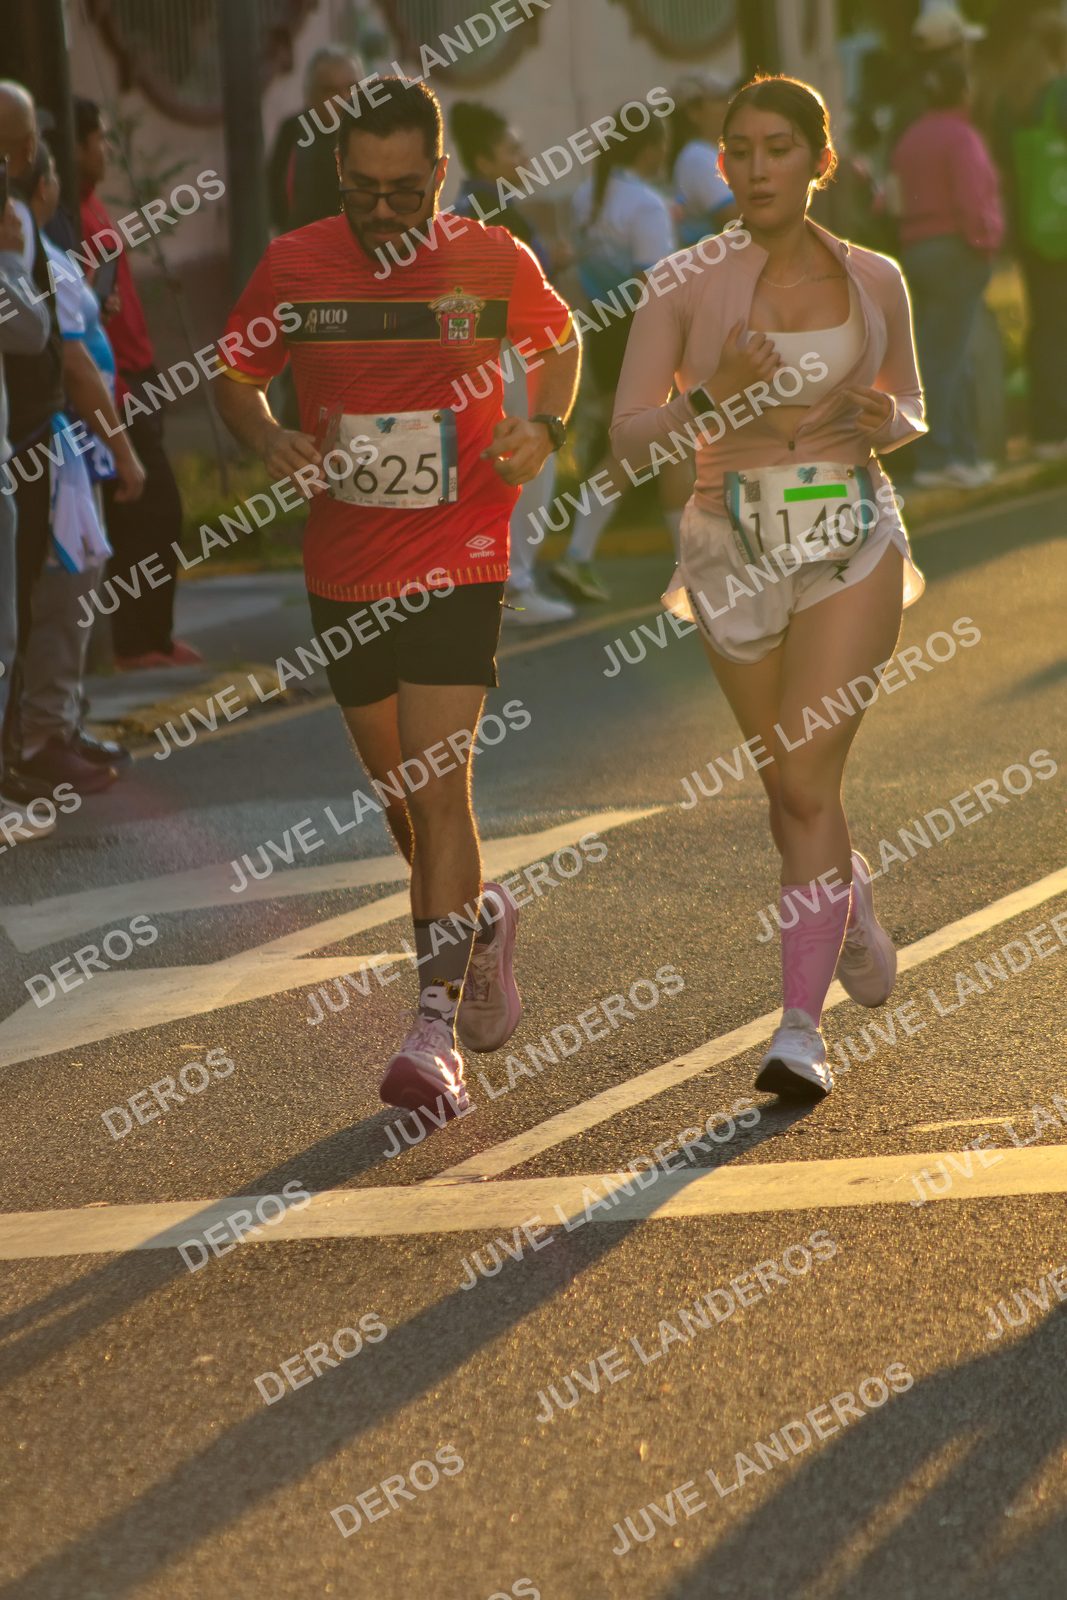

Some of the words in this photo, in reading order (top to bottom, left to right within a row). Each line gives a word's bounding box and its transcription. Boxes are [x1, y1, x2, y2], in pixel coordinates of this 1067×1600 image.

[319, 308, 348, 325] 100
[335, 452, 439, 495] 1625
[748, 503, 860, 552] 1140
[469, 550, 496, 559] umbro
